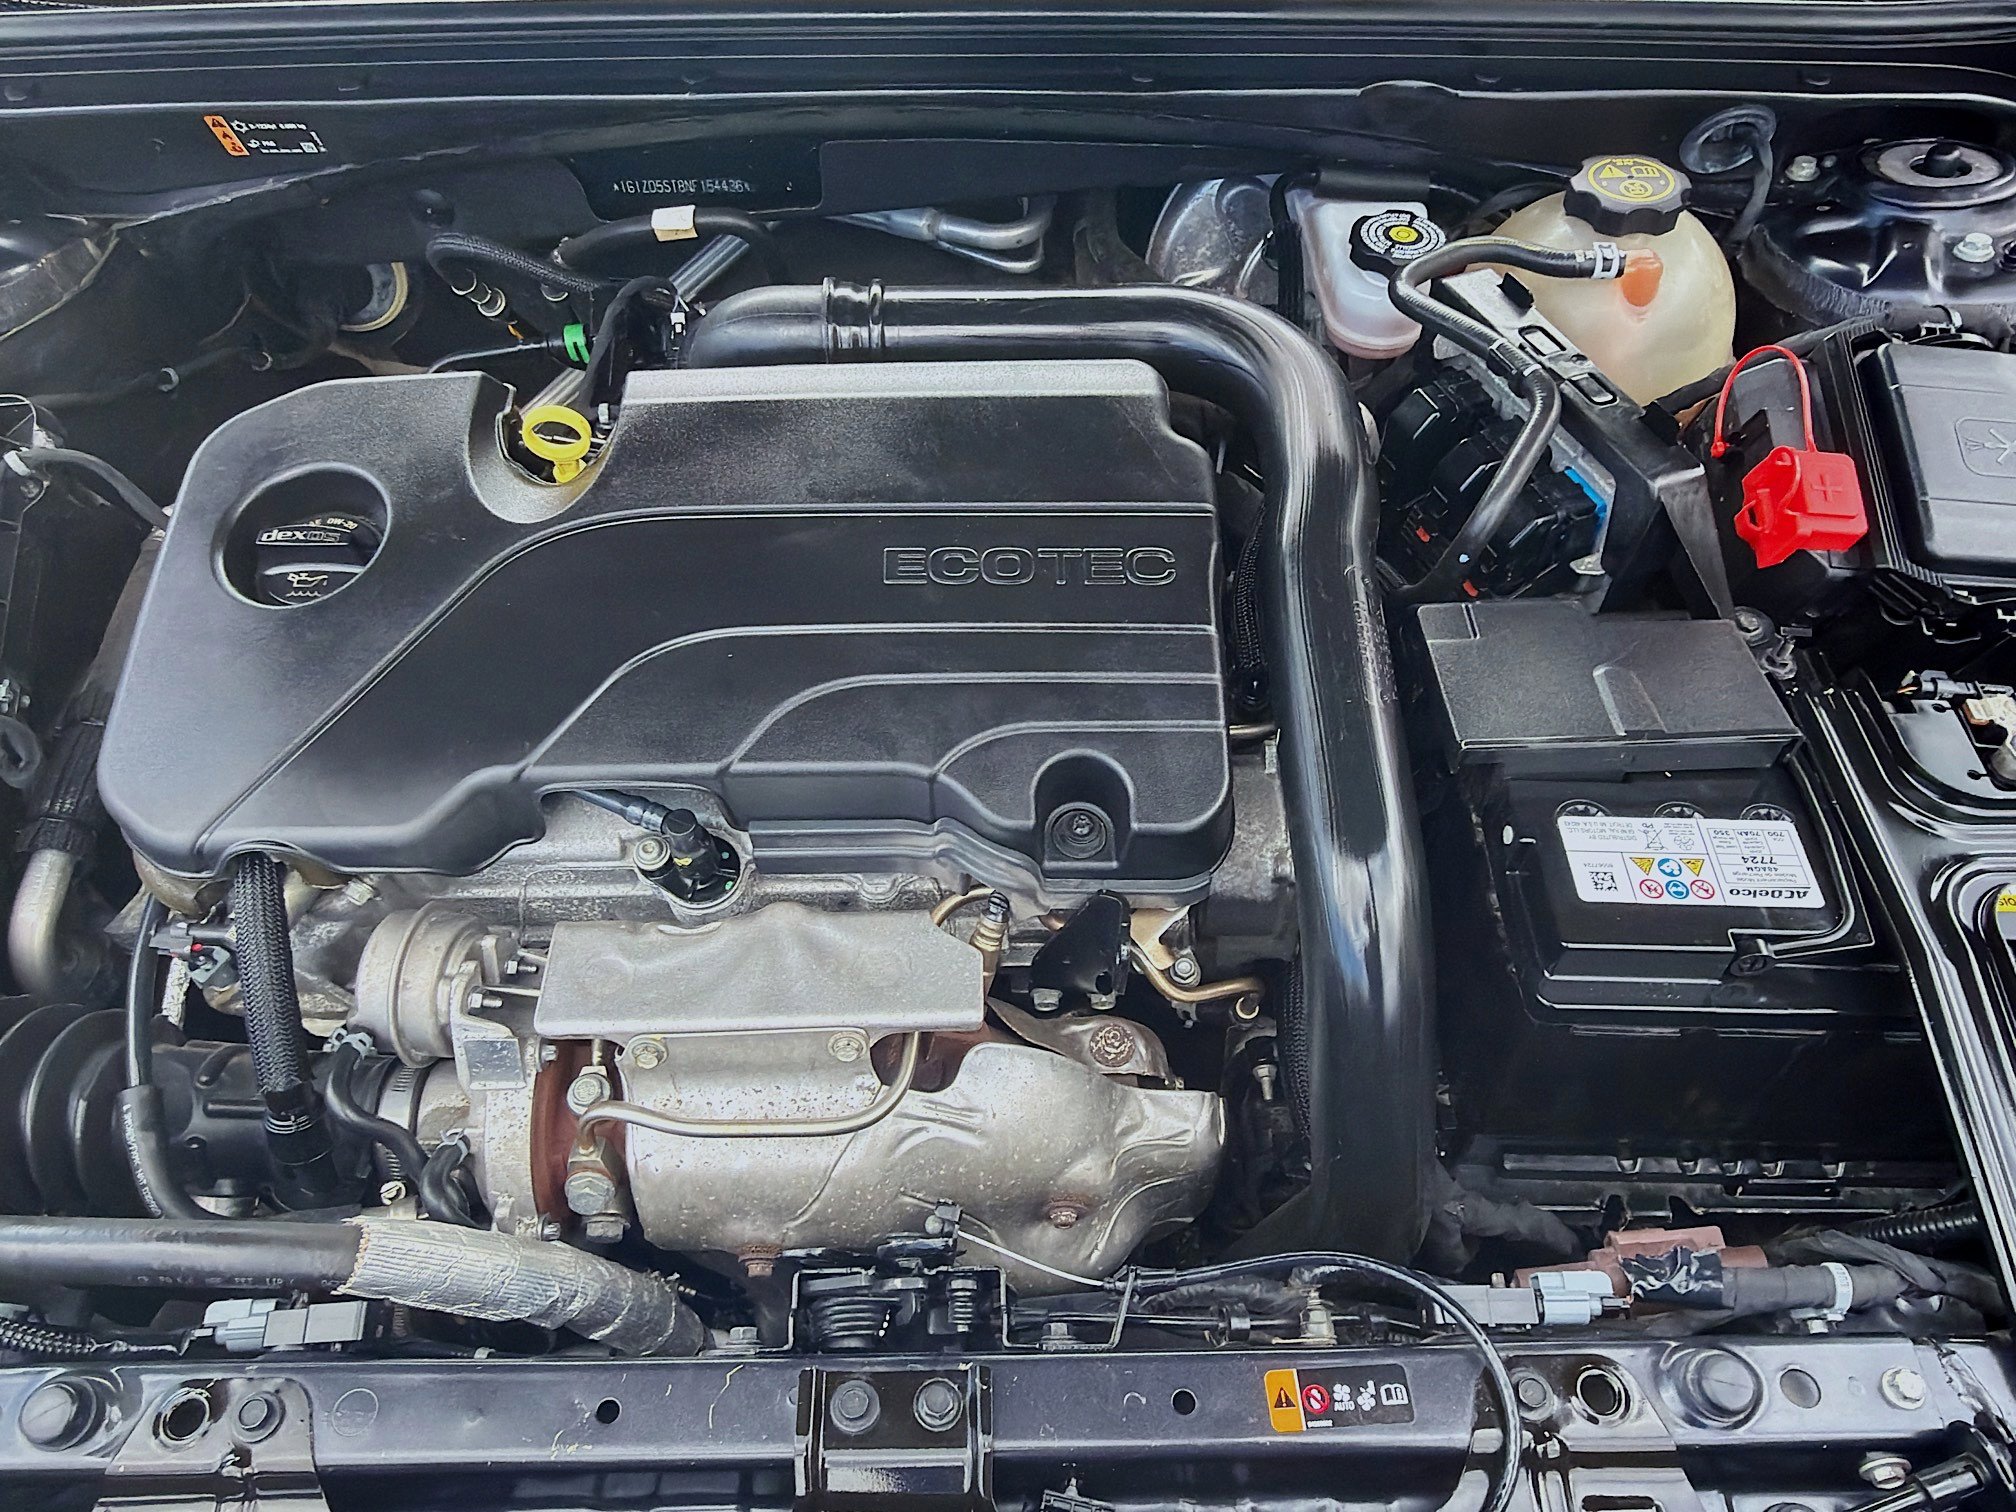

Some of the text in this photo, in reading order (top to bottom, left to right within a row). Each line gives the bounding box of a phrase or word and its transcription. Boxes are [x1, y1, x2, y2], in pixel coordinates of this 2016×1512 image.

[882, 546, 1177, 586] ECOTEC
[1741, 856, 1778, 865] 7724
[1729, 888, 1809, 899] ACDelco
[1334, 1400, 1355, 1412] AUTO
